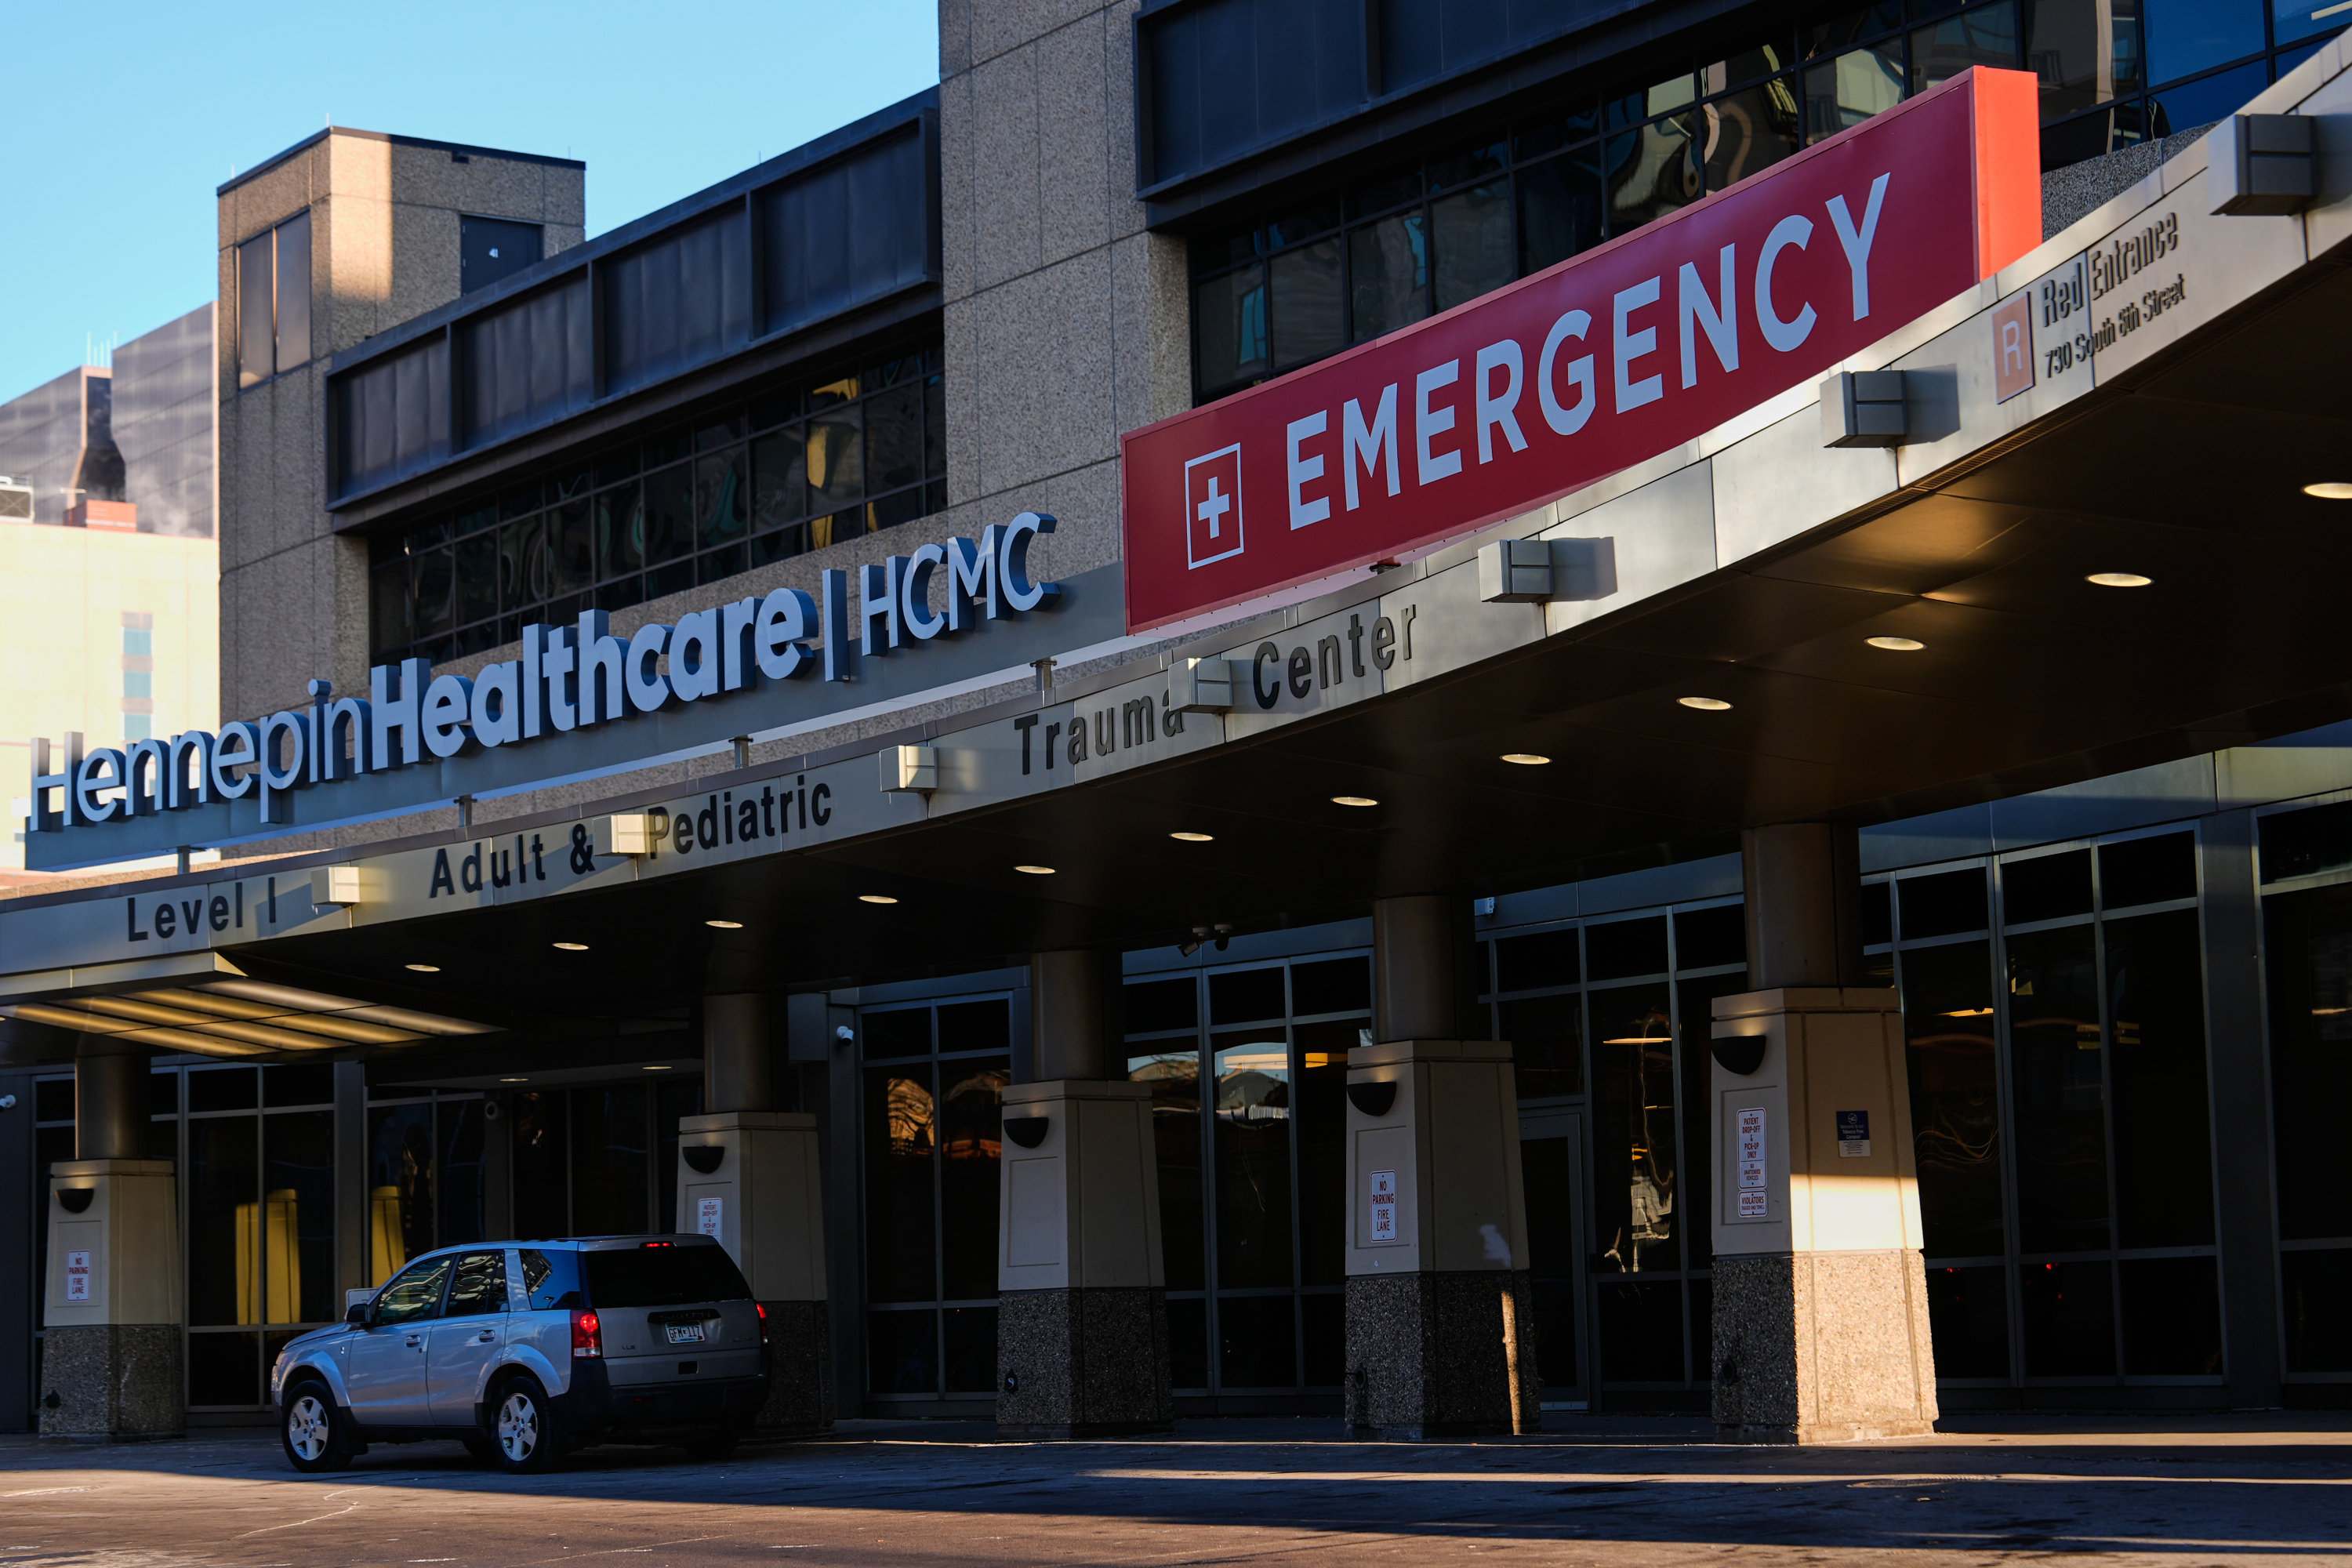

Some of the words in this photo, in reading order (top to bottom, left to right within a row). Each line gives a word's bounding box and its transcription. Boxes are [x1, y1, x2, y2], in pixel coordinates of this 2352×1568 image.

[2041, 262, 2084, 328] Red
[2089, 212, 2179, 301] Entrance
[2044, 341, 2072, 379] 730
[2075, 317, 2116, 362] South
[2142, 273, 2187, 322] Street
[1287, 172, 1890, 531] EMERGENCY
[2002, 320, 2024, 377] R
[31, 587, 818, 832] HennepinHealthcare
[860, 511, 1062, 656] HCMC
[127, 881, 243, 942] Level
[430, 833, 546, 898] Adult
[570, 823, 597, 875] &
[648, 774, 833, 860] Pediatric
[1014, 688, 1185, 775] Trauma
[1254, 604, 1417, 710] Center
[1744, 1116, 1759, 1125] PATIENT
[1742, 1125, 1761, 1134] DROP-OFF
[1379, 1180, 1387, 1192] NO
[1372, 1192, 1395, 1205] PARKING
[1741, 1196, 1764, 1205] VIOLATORS
[1377, 1209, 1389, 1220] FIRE
[1377, 1220, 1391, 1232] LANE
[75, 1257, 82, 1265] NO
[69, 1266, 89, 1275] PARKING
[73, 1277, 84, 1286] FIRE
[660, 1312, 710, 1321] SATURN
[668, 1327, 684, 1339] GFM
[688, 1326, 700, 1338] 117
